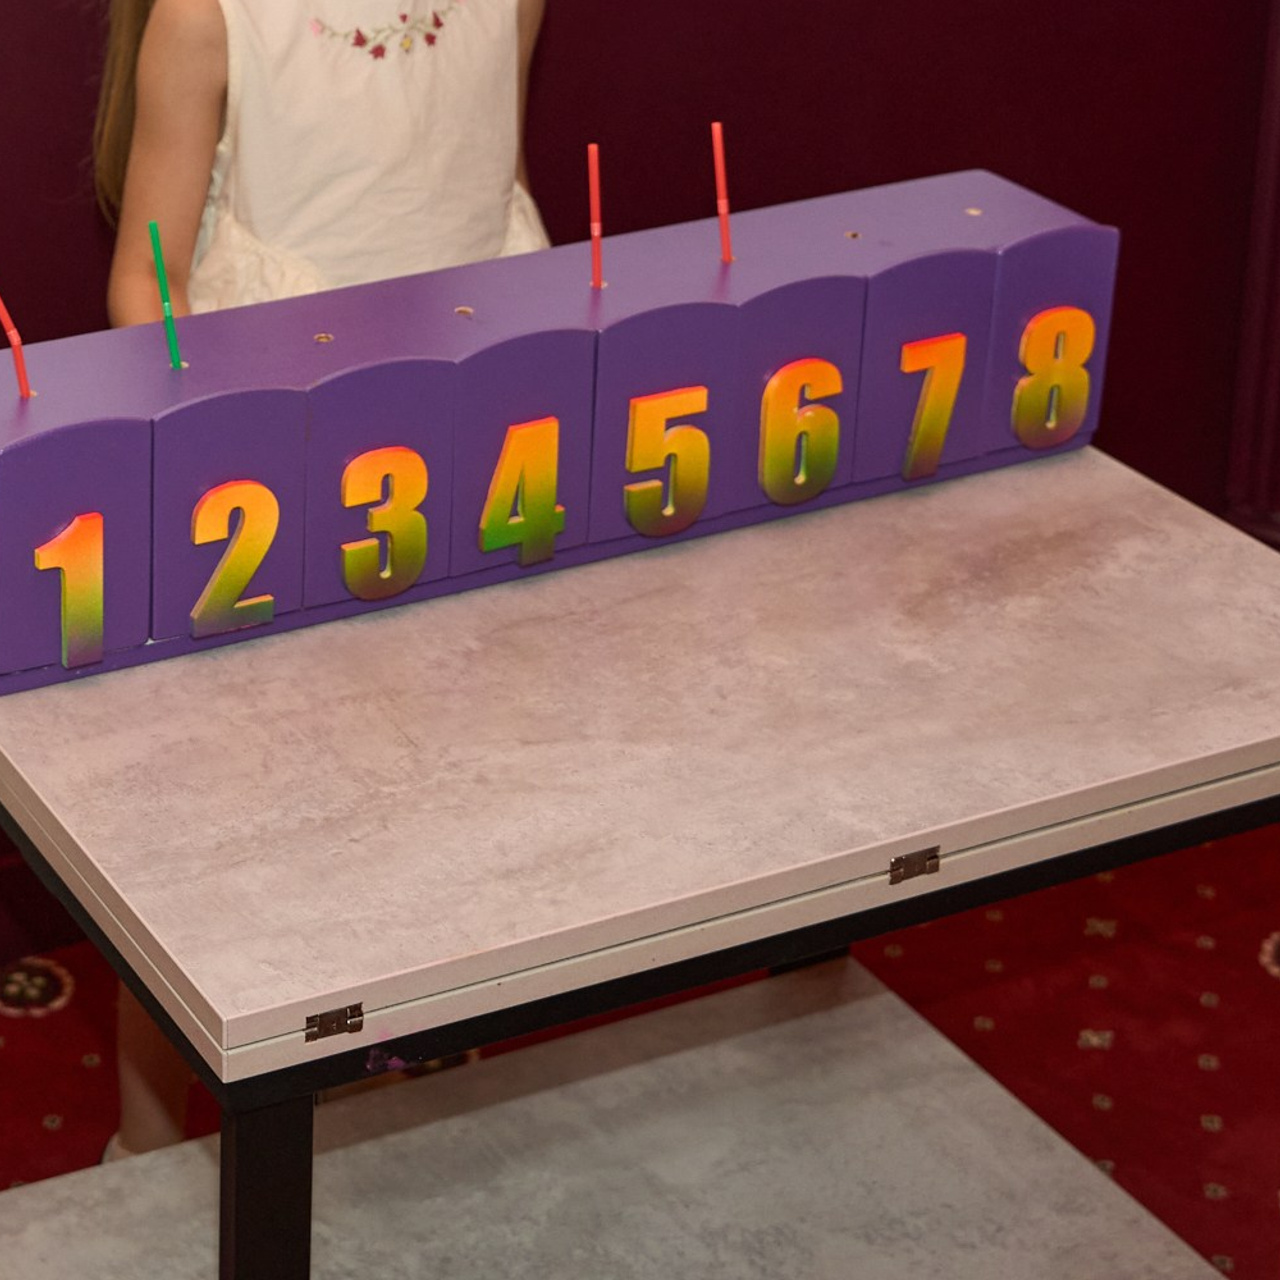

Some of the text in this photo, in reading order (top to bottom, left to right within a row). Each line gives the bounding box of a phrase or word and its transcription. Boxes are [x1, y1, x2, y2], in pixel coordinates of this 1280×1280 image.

[35, 306, 1097, 668] 1 2 3 4 5 6 7 8
